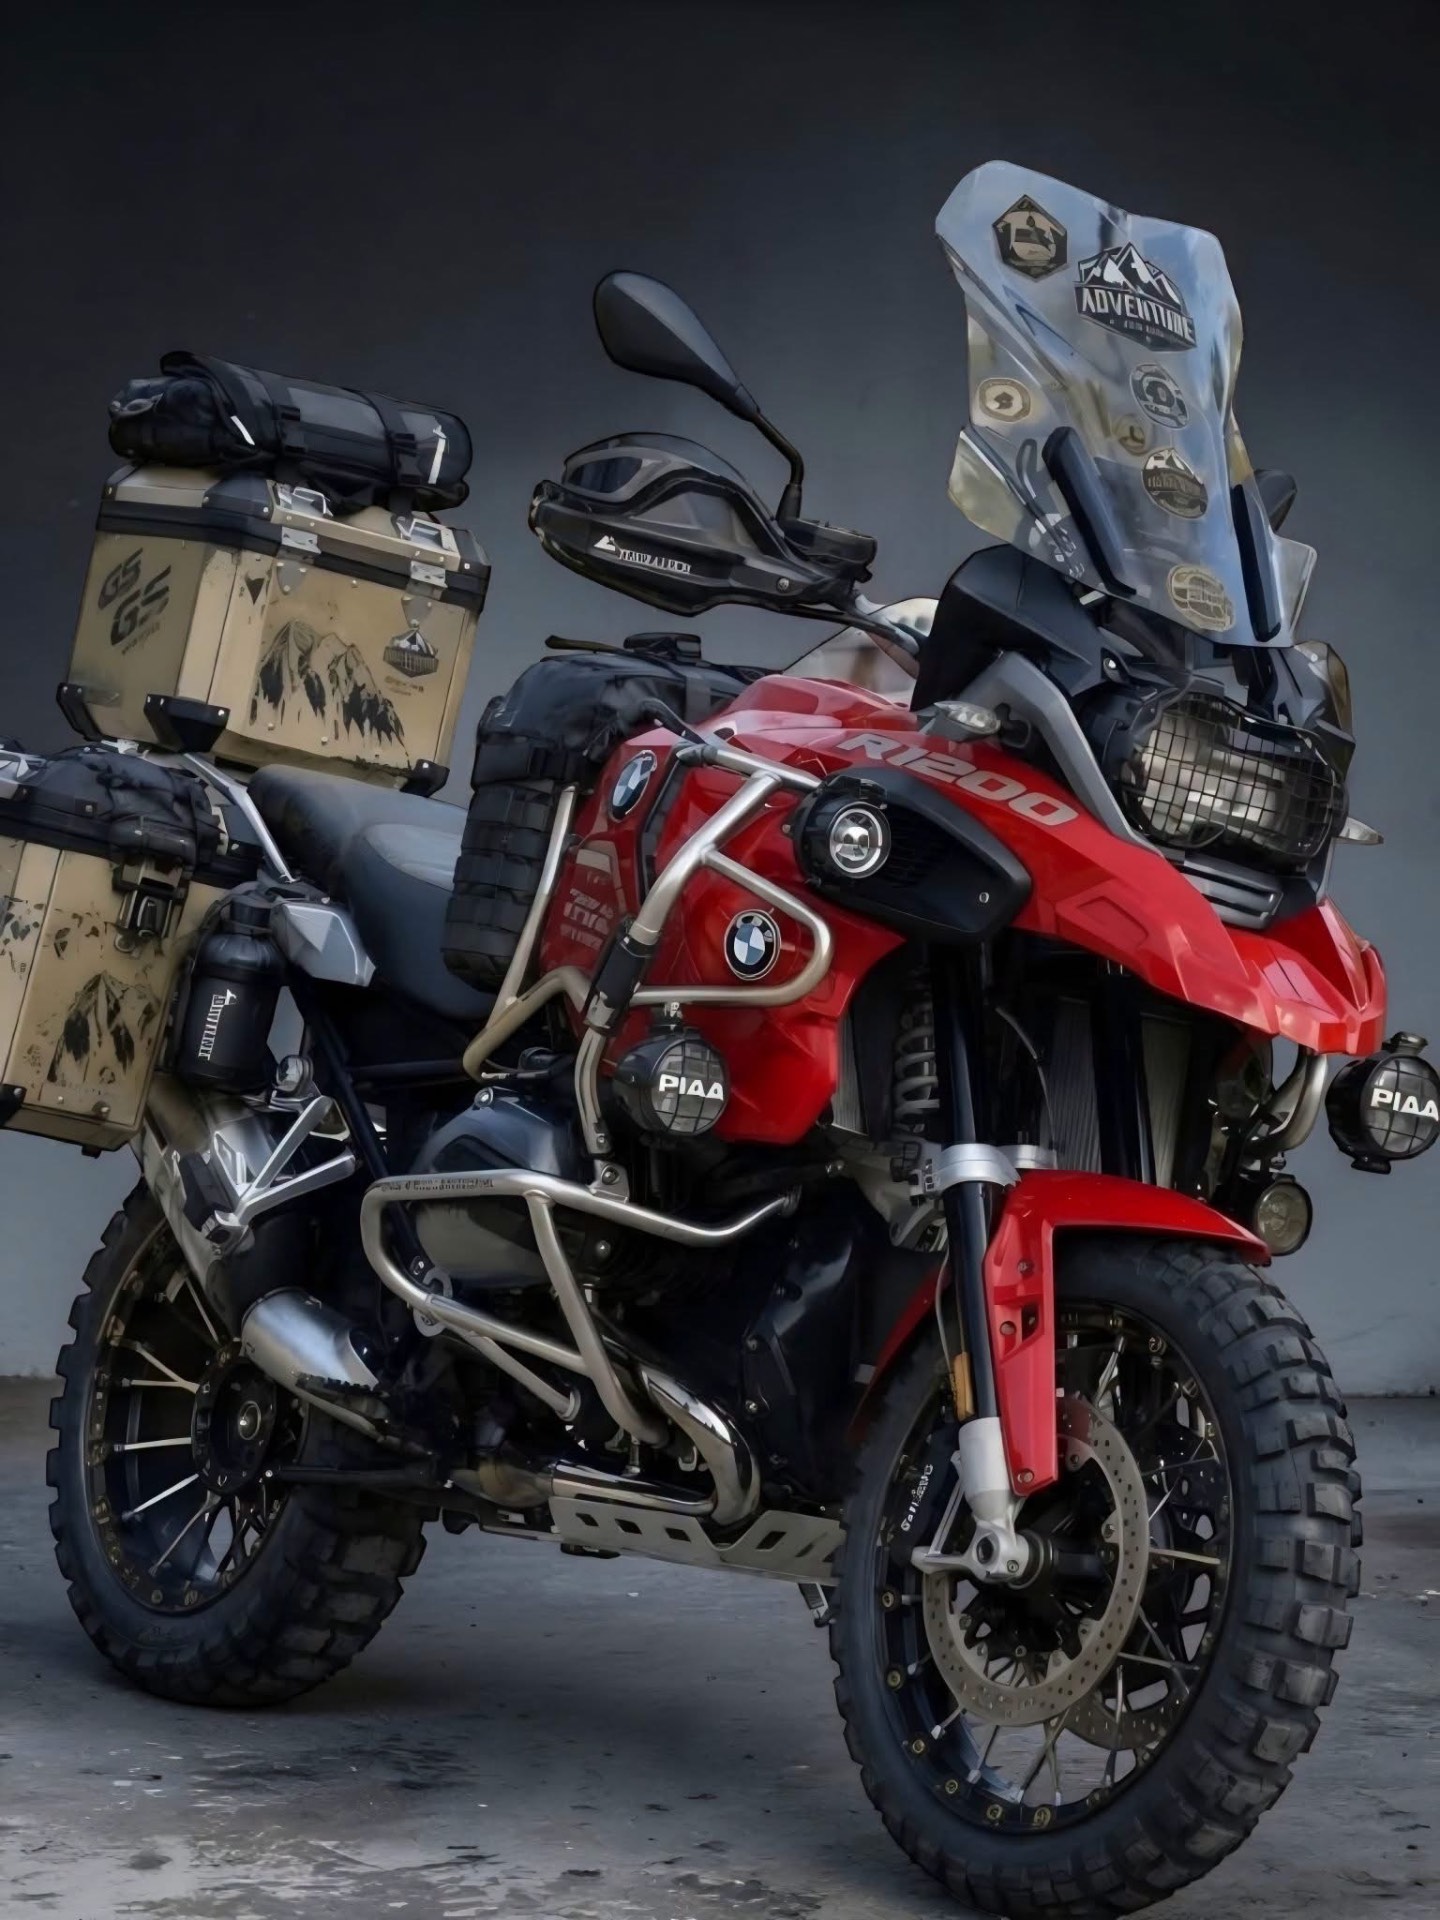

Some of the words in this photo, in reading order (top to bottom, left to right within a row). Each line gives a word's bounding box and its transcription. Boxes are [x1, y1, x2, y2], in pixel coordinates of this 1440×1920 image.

[836, 733, 1079, 826] R1200
[659, 1073, 724, 1101] PIAA
[1370, 1088, 1439, 1121] PIAA
